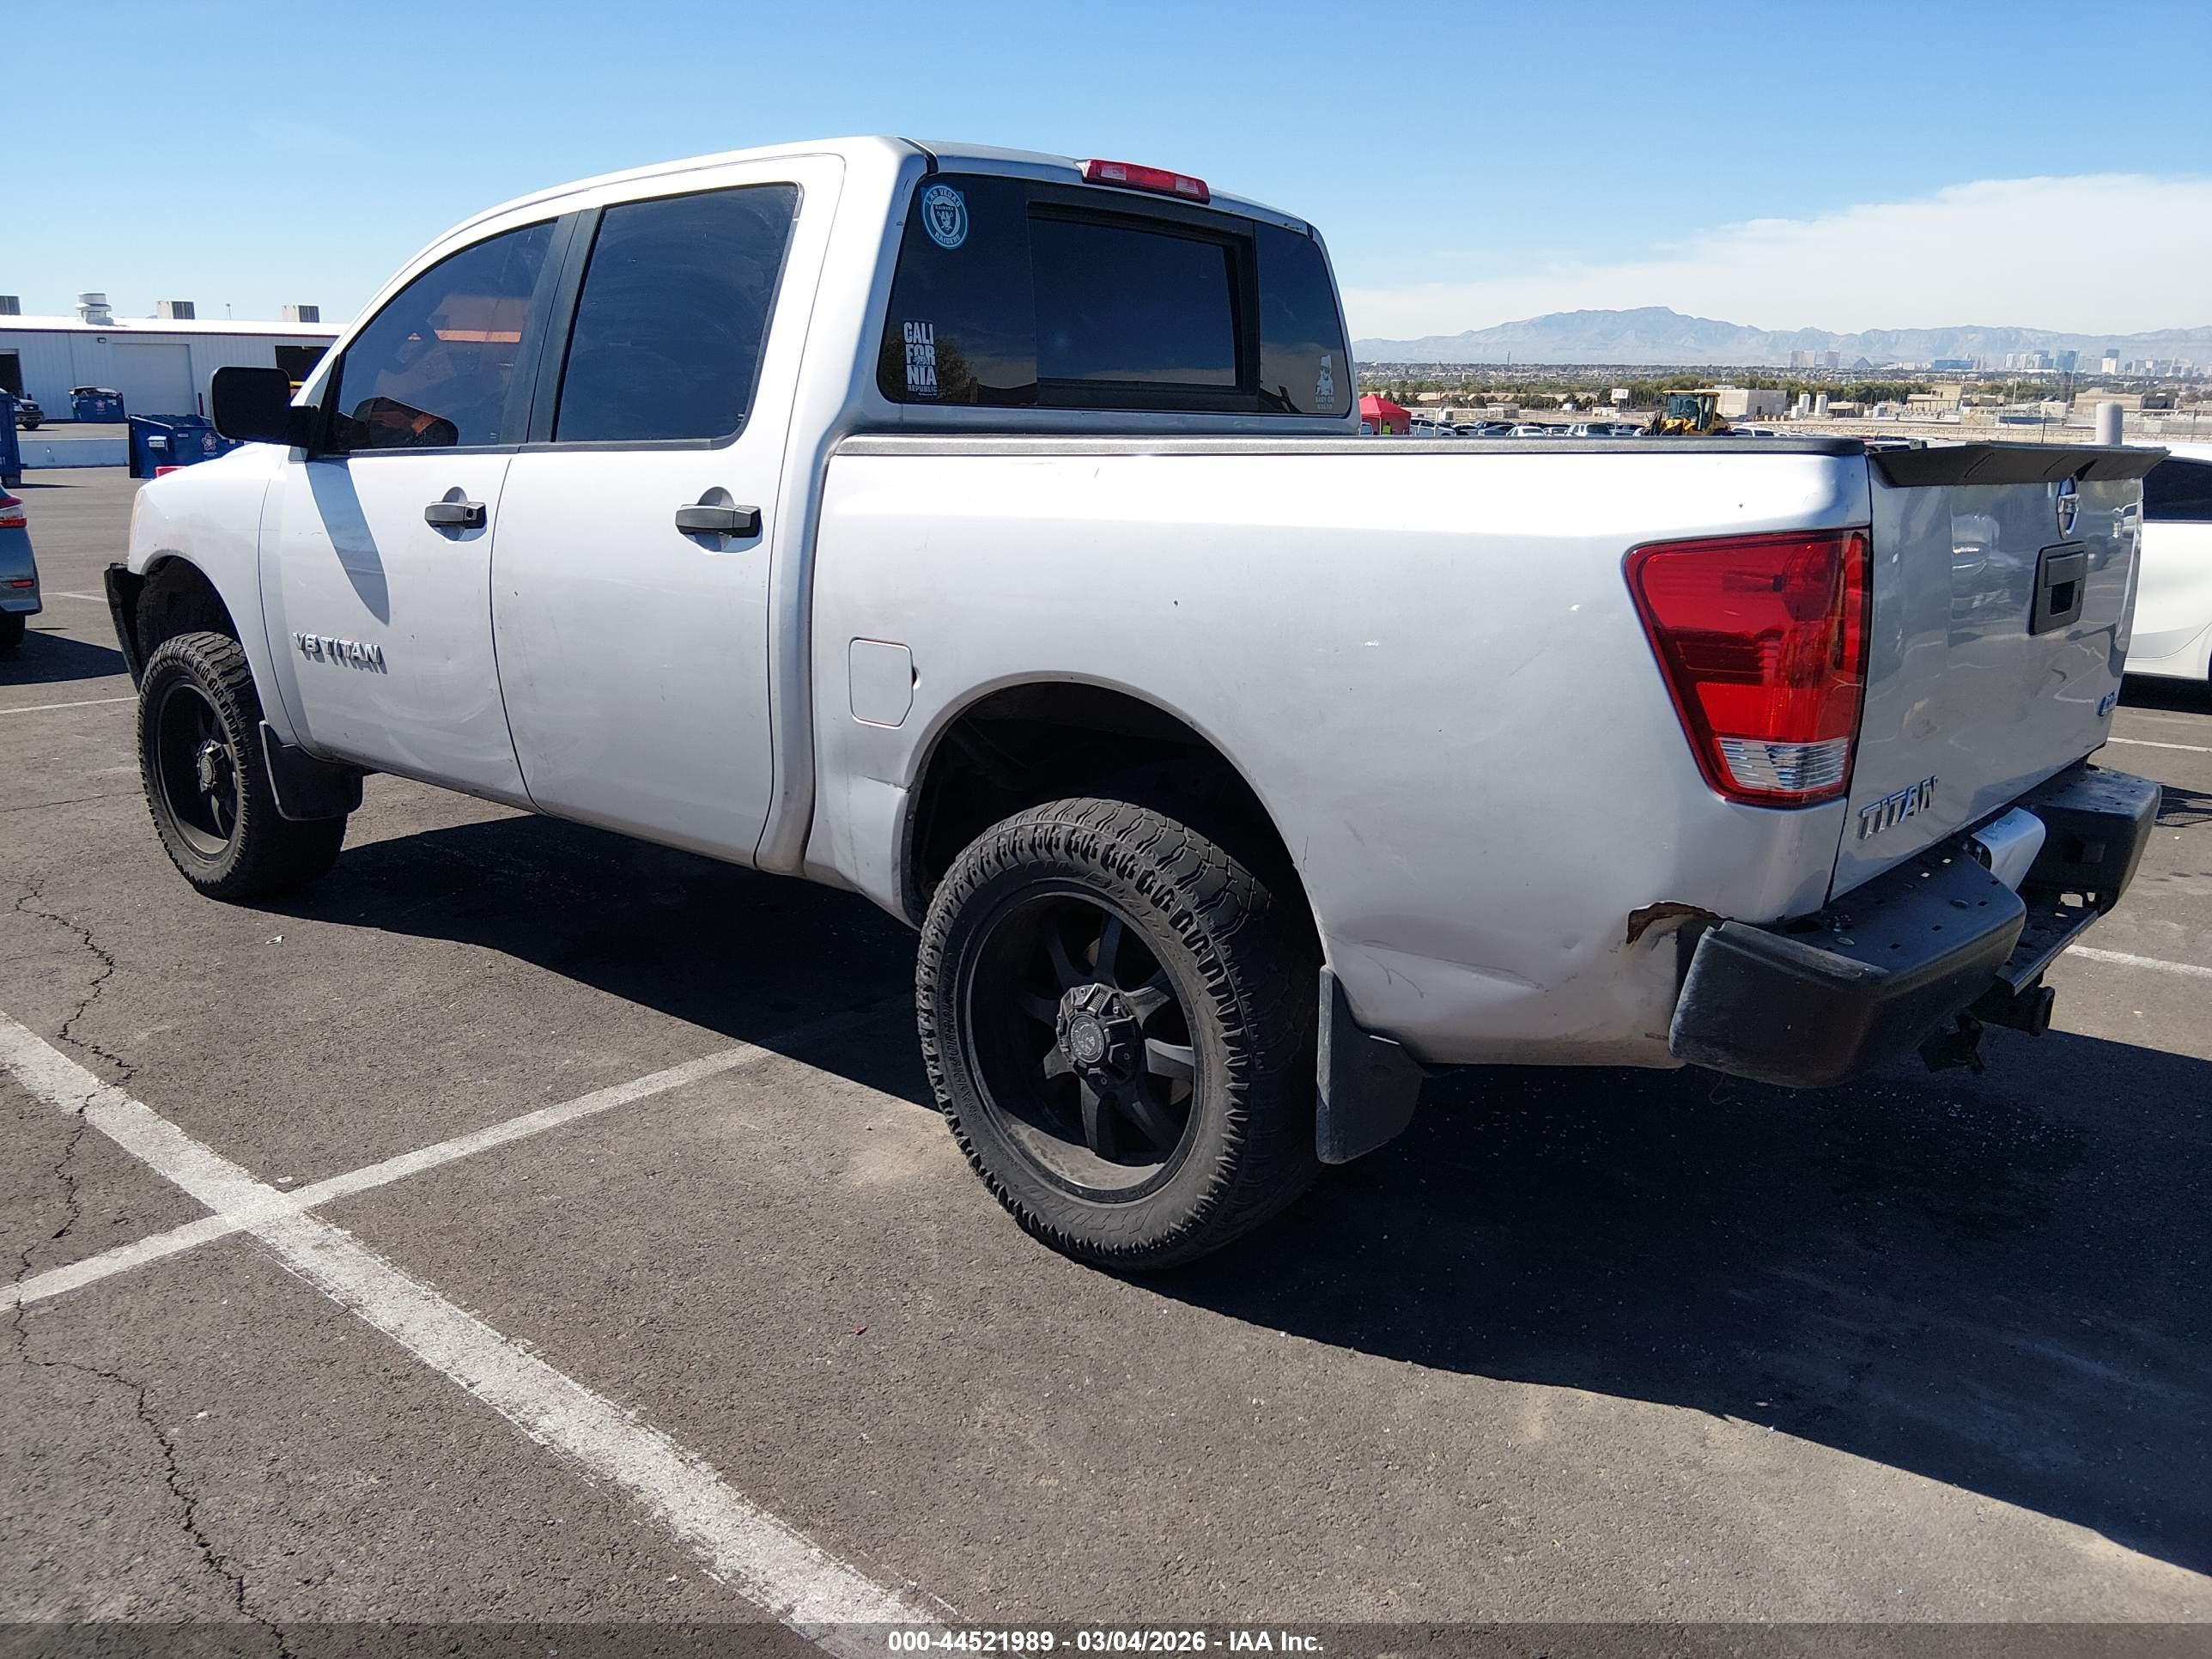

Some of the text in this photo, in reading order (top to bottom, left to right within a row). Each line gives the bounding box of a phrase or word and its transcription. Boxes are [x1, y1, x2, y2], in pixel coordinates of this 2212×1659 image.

[926, 188, 962, 208] LAS VEGAS
[934, 232, 961, 245] RAIDERS
[903, 321, 934, 345] CALI
[905, 343, 936, 366] FOR
[906, 364, 938, 386] NIA
[320, 636, 381, 664] TITAN
[1858, 775, 1938, 840] TITAN
